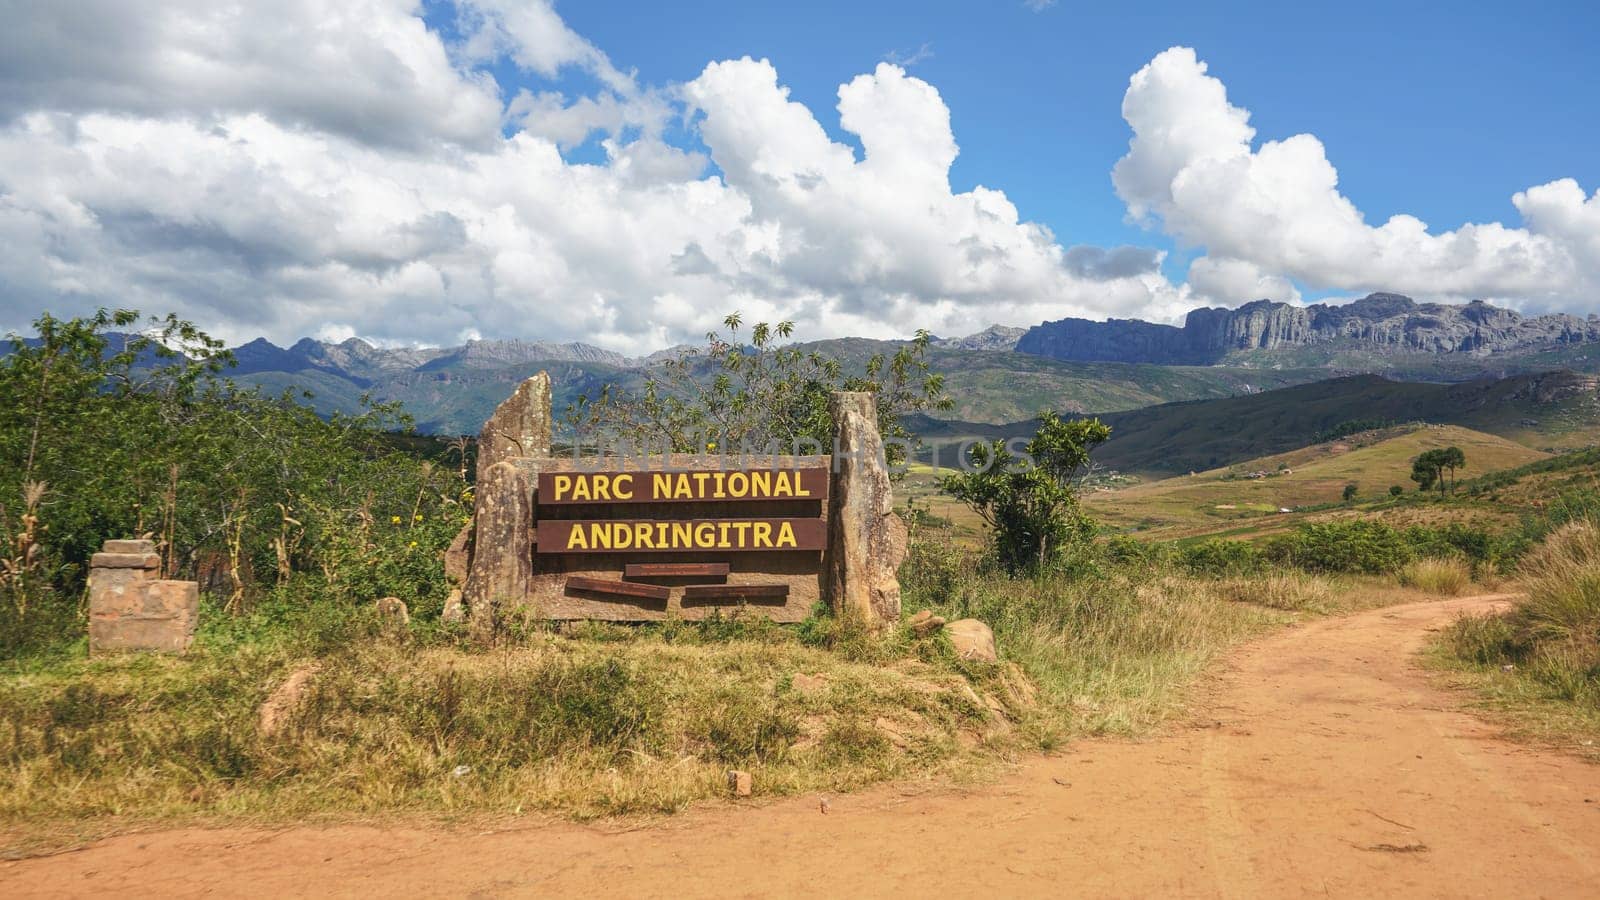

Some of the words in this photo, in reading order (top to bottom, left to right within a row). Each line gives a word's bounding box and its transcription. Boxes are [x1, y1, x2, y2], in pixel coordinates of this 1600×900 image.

[554, 473, 634, 501] PARC
[653, 471, 811, 499] NATIONAL
[567, 521, 798, 550] ANDRINGITRA
